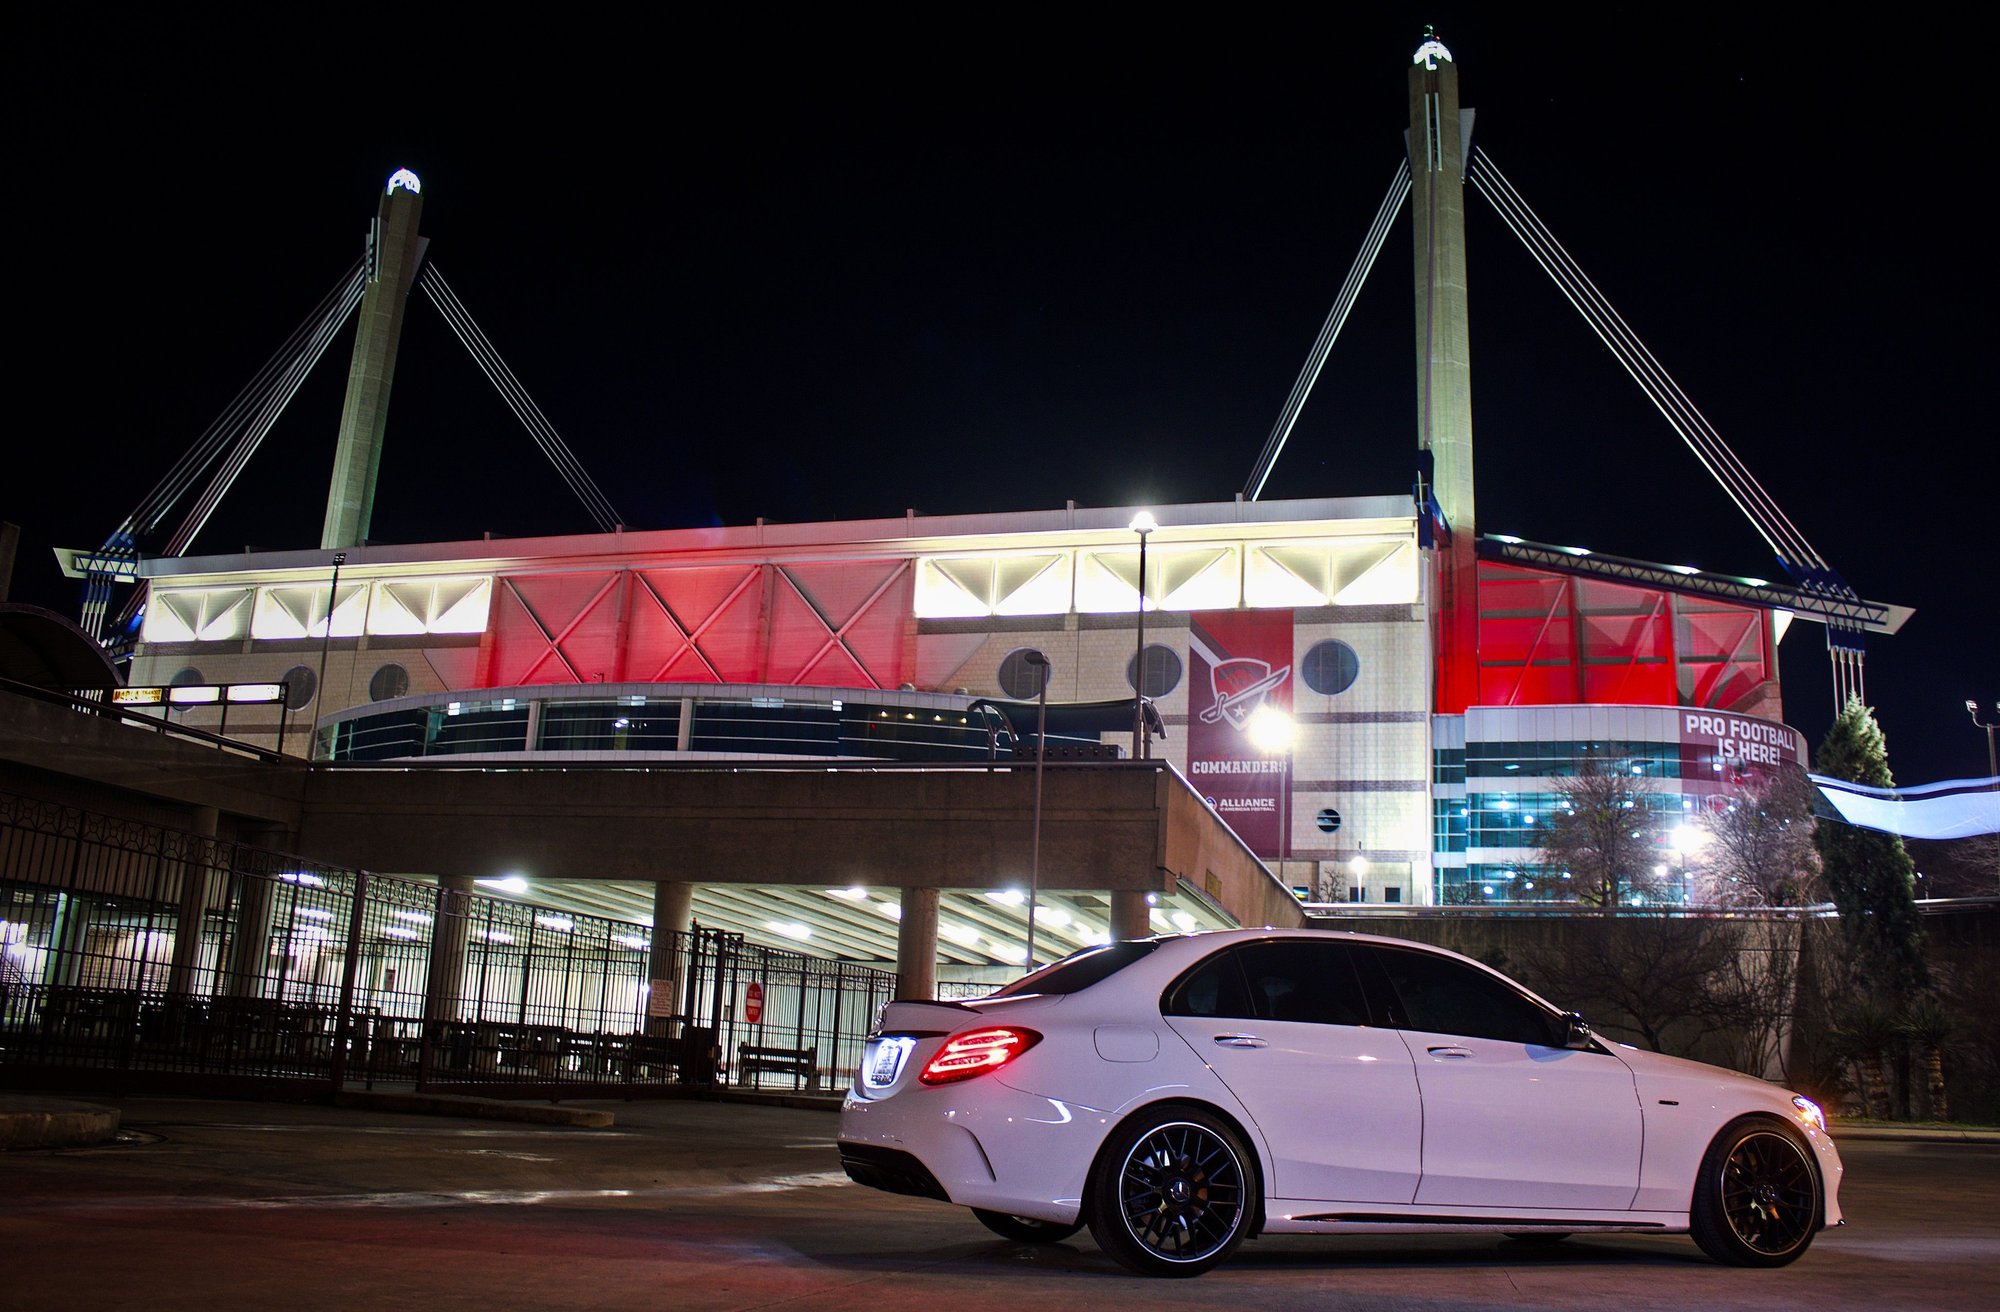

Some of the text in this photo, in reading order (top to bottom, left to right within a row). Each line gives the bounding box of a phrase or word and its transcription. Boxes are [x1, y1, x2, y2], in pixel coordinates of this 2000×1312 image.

[1686, 715, 1795, 751] PRO FOOTBALL
[1718, 738, 1781, 766] IS HERE!
[1192, 761, 1287, 774] COMMANDERS
[1220, 798, 1275, 807] ALLIANCE
